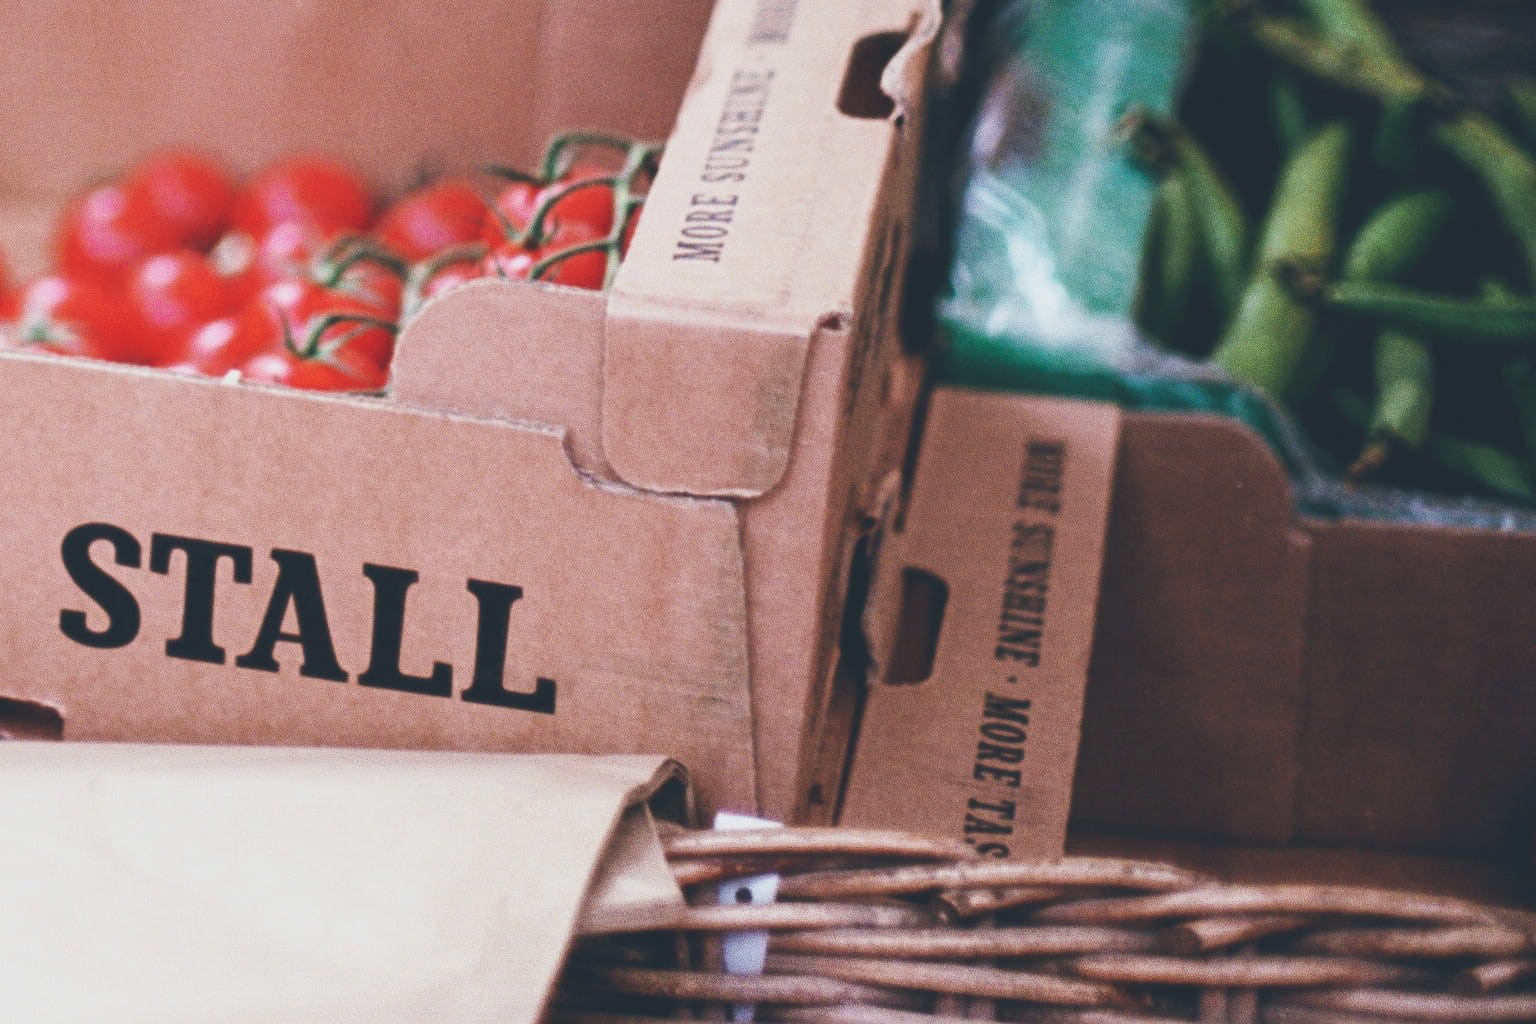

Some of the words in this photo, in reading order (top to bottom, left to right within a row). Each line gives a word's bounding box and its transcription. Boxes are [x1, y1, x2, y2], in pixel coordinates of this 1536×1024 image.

[702, 68, 776, 184] SUNSHINE
[673, 193, 739, 265] MORE
[59, 522, 557, 715] STALL
[994, 522, 1057, 669] SUNSHINE
[972, 691, 1032, 789] MORE
